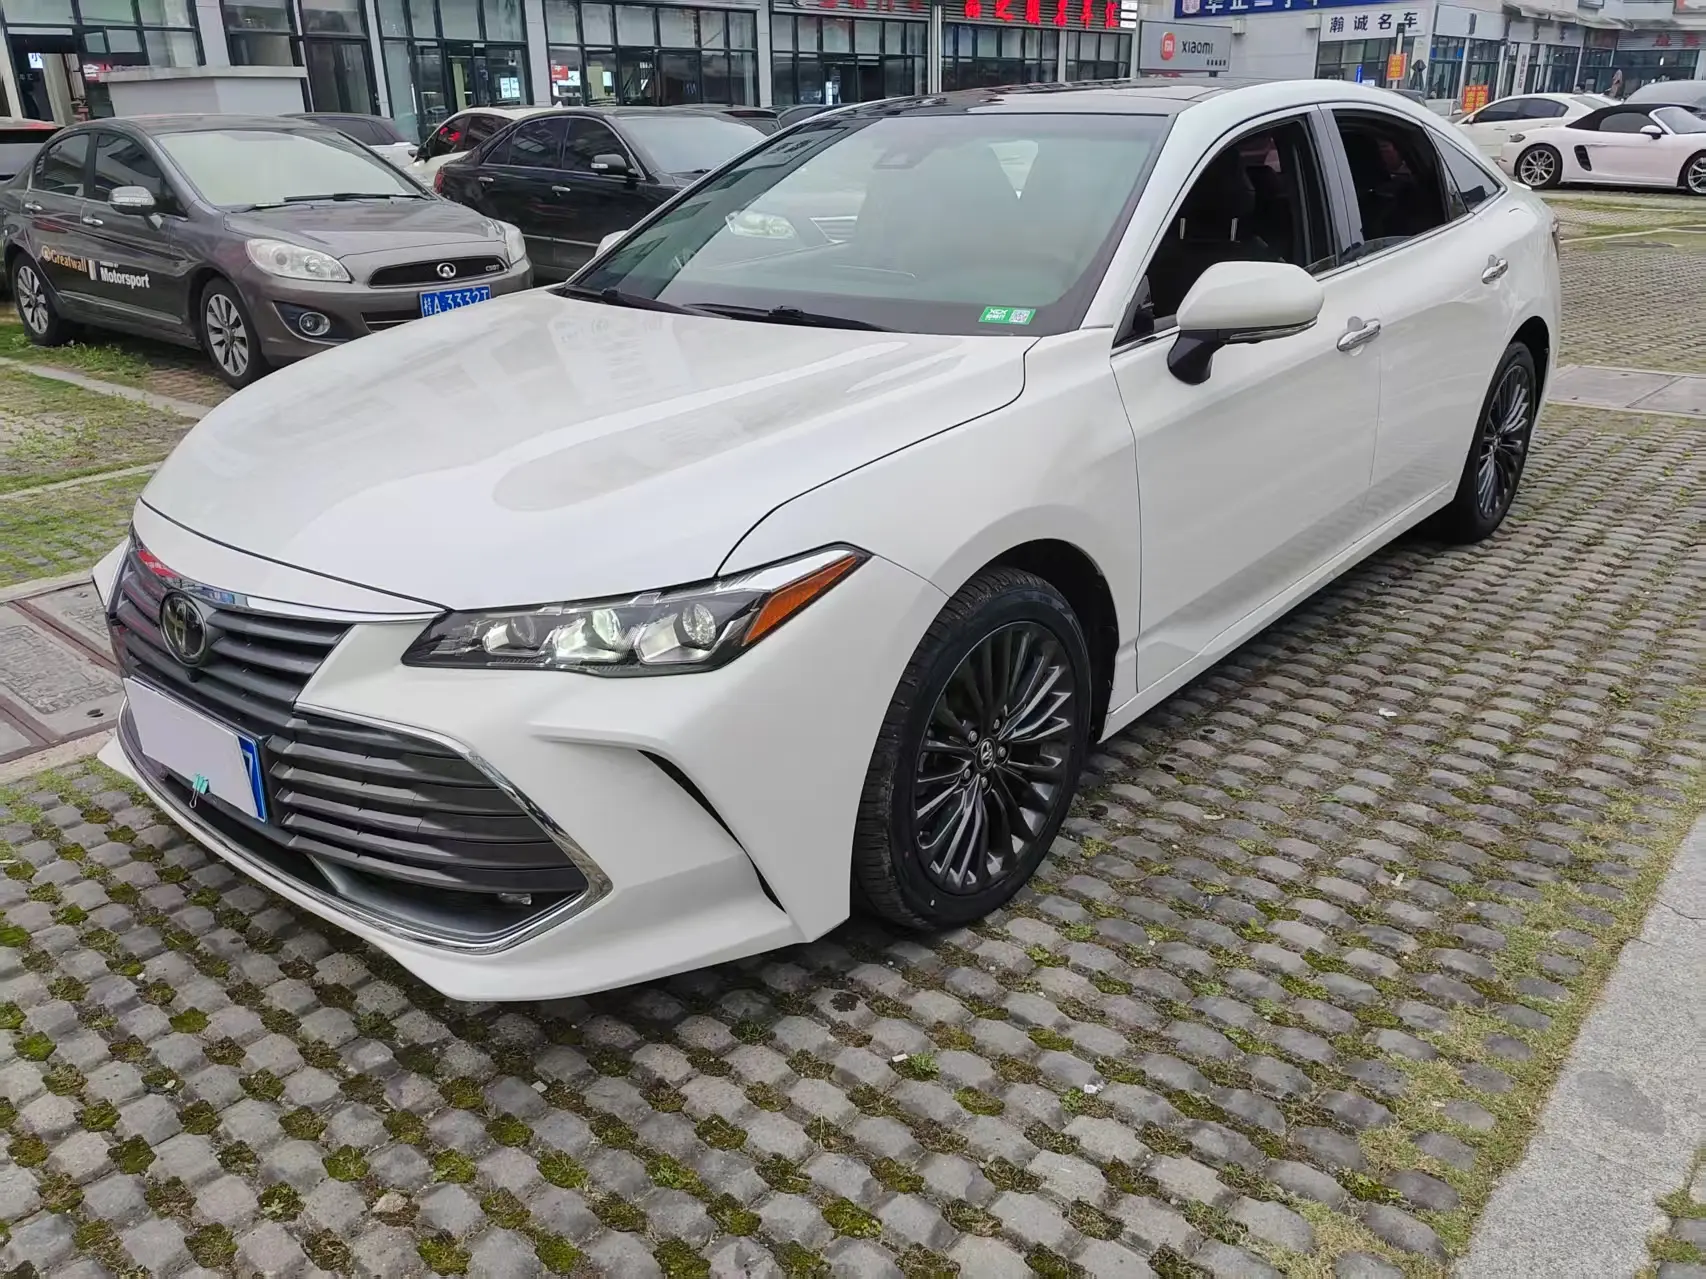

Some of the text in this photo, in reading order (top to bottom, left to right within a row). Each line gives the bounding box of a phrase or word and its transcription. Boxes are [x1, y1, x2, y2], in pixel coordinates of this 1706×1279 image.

[1329, 12, 1418, 34] 瀚诚名车
[1181, 40, 1214, 55] xiaomi
[100, 266, 150, 289] Motorsport
